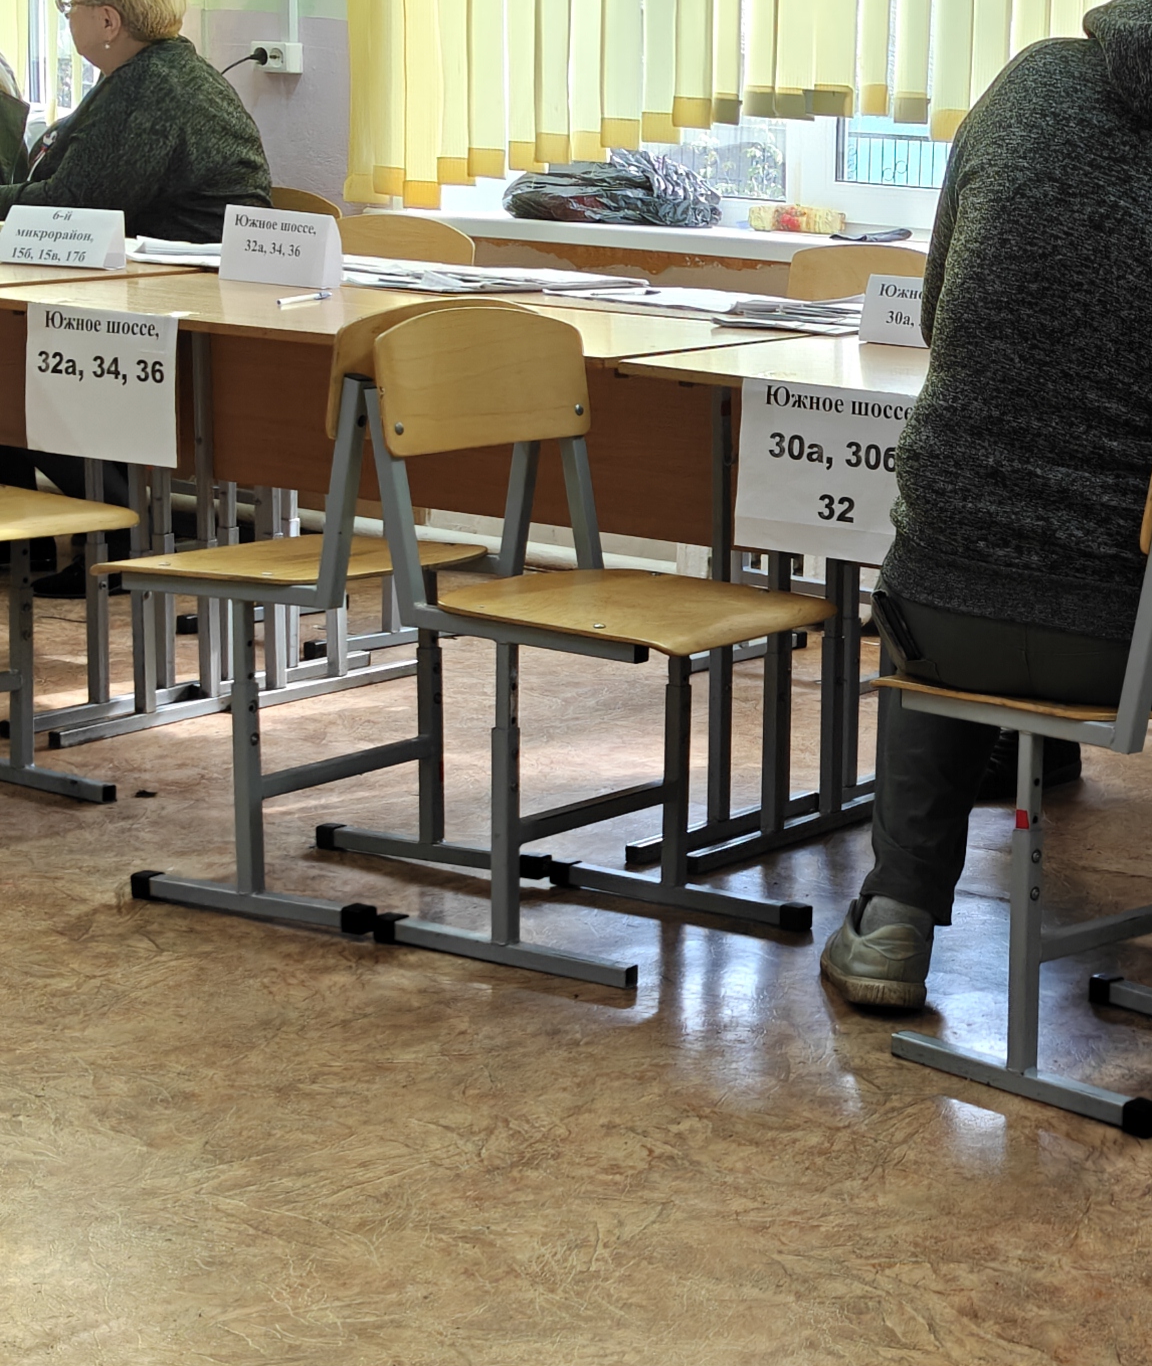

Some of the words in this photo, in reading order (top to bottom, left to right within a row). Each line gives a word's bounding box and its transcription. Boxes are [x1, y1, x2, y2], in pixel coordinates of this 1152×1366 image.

[52, 210, 73, 221] 6-й
[234, 214, 278, 230] Южное
[280, 221, 317, 235] шоссе,
[16, 228, 94, 242] микрорайон,
[12, 247, 34, 260] 15б,
[66, 251, 87, 262] 17б
[244, 239, 267, 254] 32а,
[269, 242, 286, 256] 34,
[288, 244, 301, 257] 36
[45, 310, 101, 332] Южное
[106, 321, 160, 340] шоссе,
[885, 310, 915, 328] 30а,
[37, 350, 84, 382] 32а,
[92, 355, 127, 386] 34,
[136, 359, 165, 384] 36
[765, 385, 844, 413] Южное
[768, 432, 833, 471] 30а,
[817, 494, 855, 524] 32
